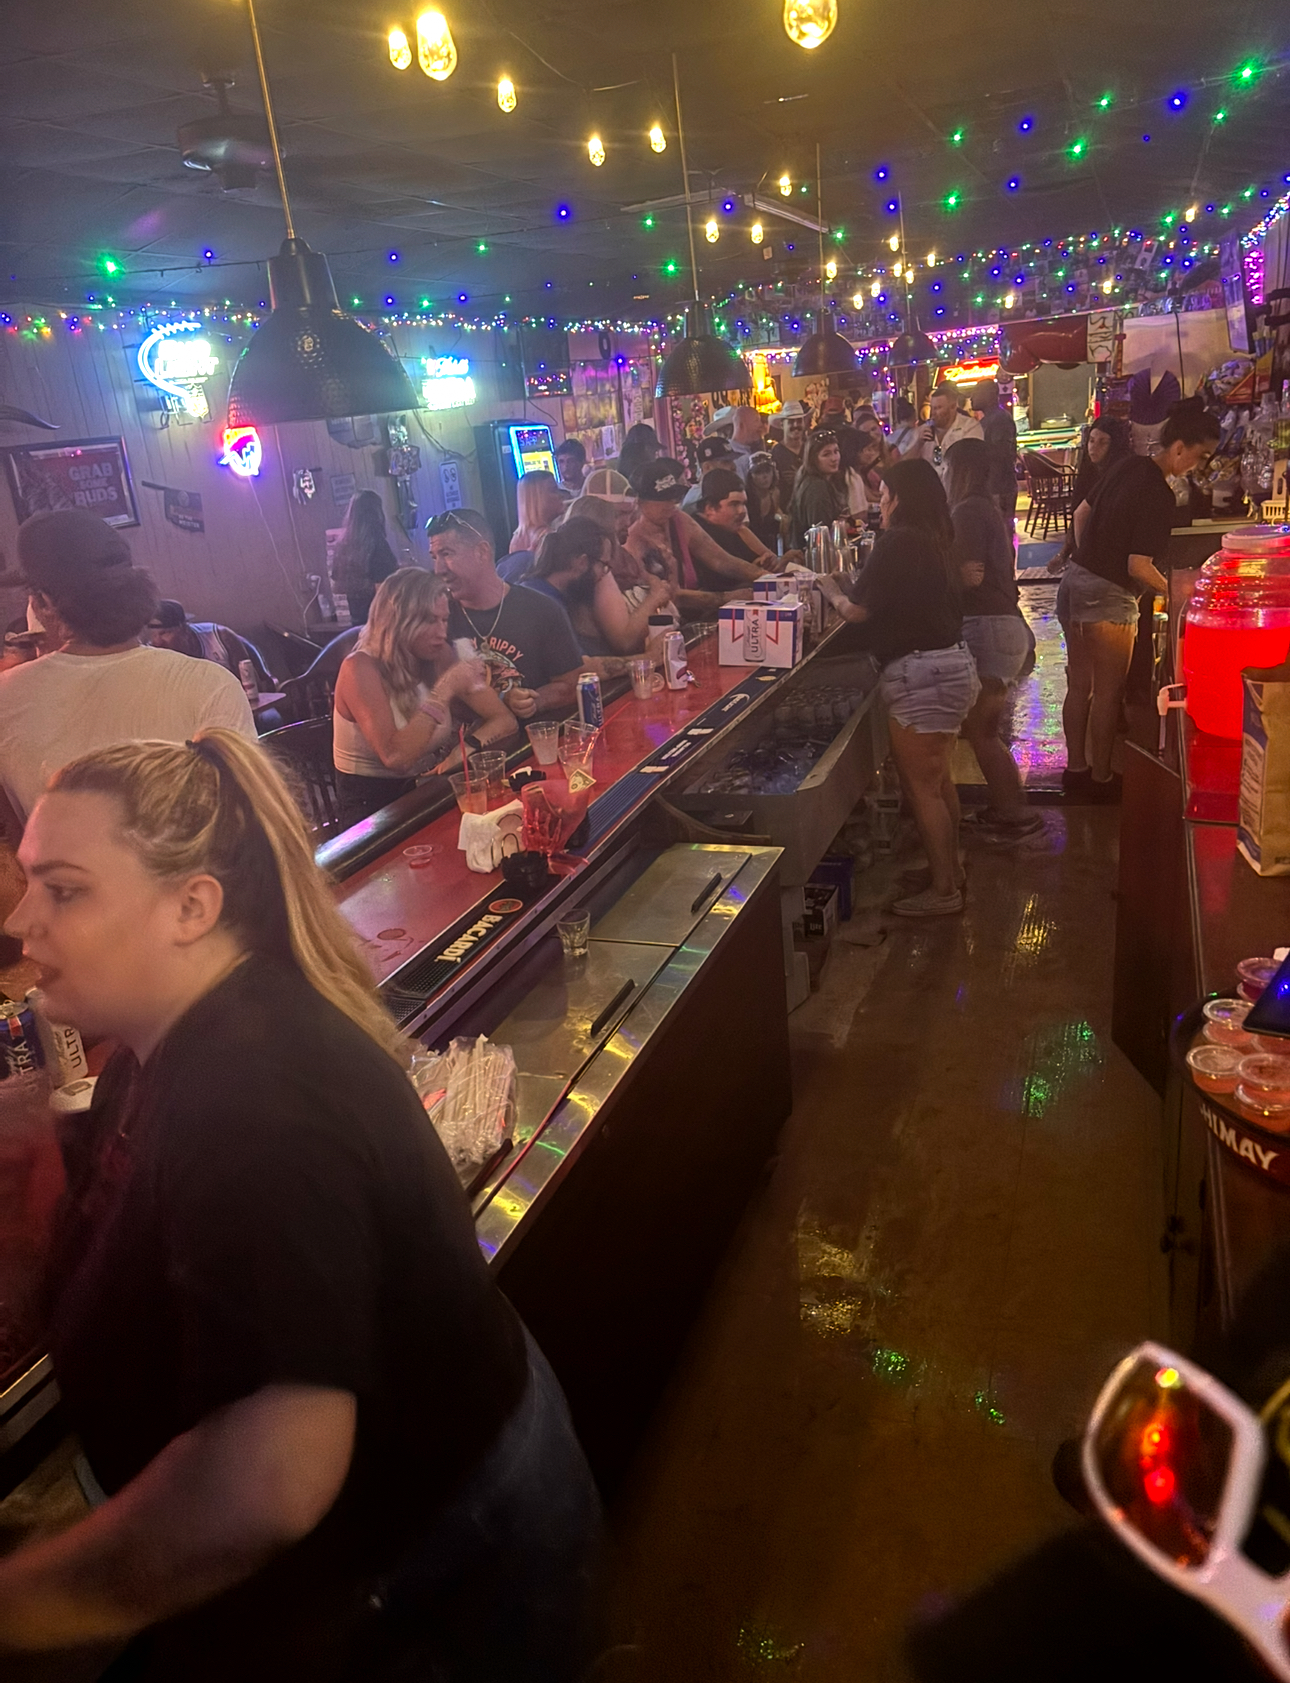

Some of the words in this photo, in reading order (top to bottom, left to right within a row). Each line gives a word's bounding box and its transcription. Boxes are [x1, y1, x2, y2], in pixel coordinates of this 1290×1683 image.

[68, 462, 114, 481] GRAB
[73, 486, 118, 507] BUDS
[489, 636, 525, 663] RIPPY
[751, 618, 760, 653] ULTRA
[64, 1027, 82, 1069] ULTR
[1200, 1103, 1280, 1171] HIMAY
